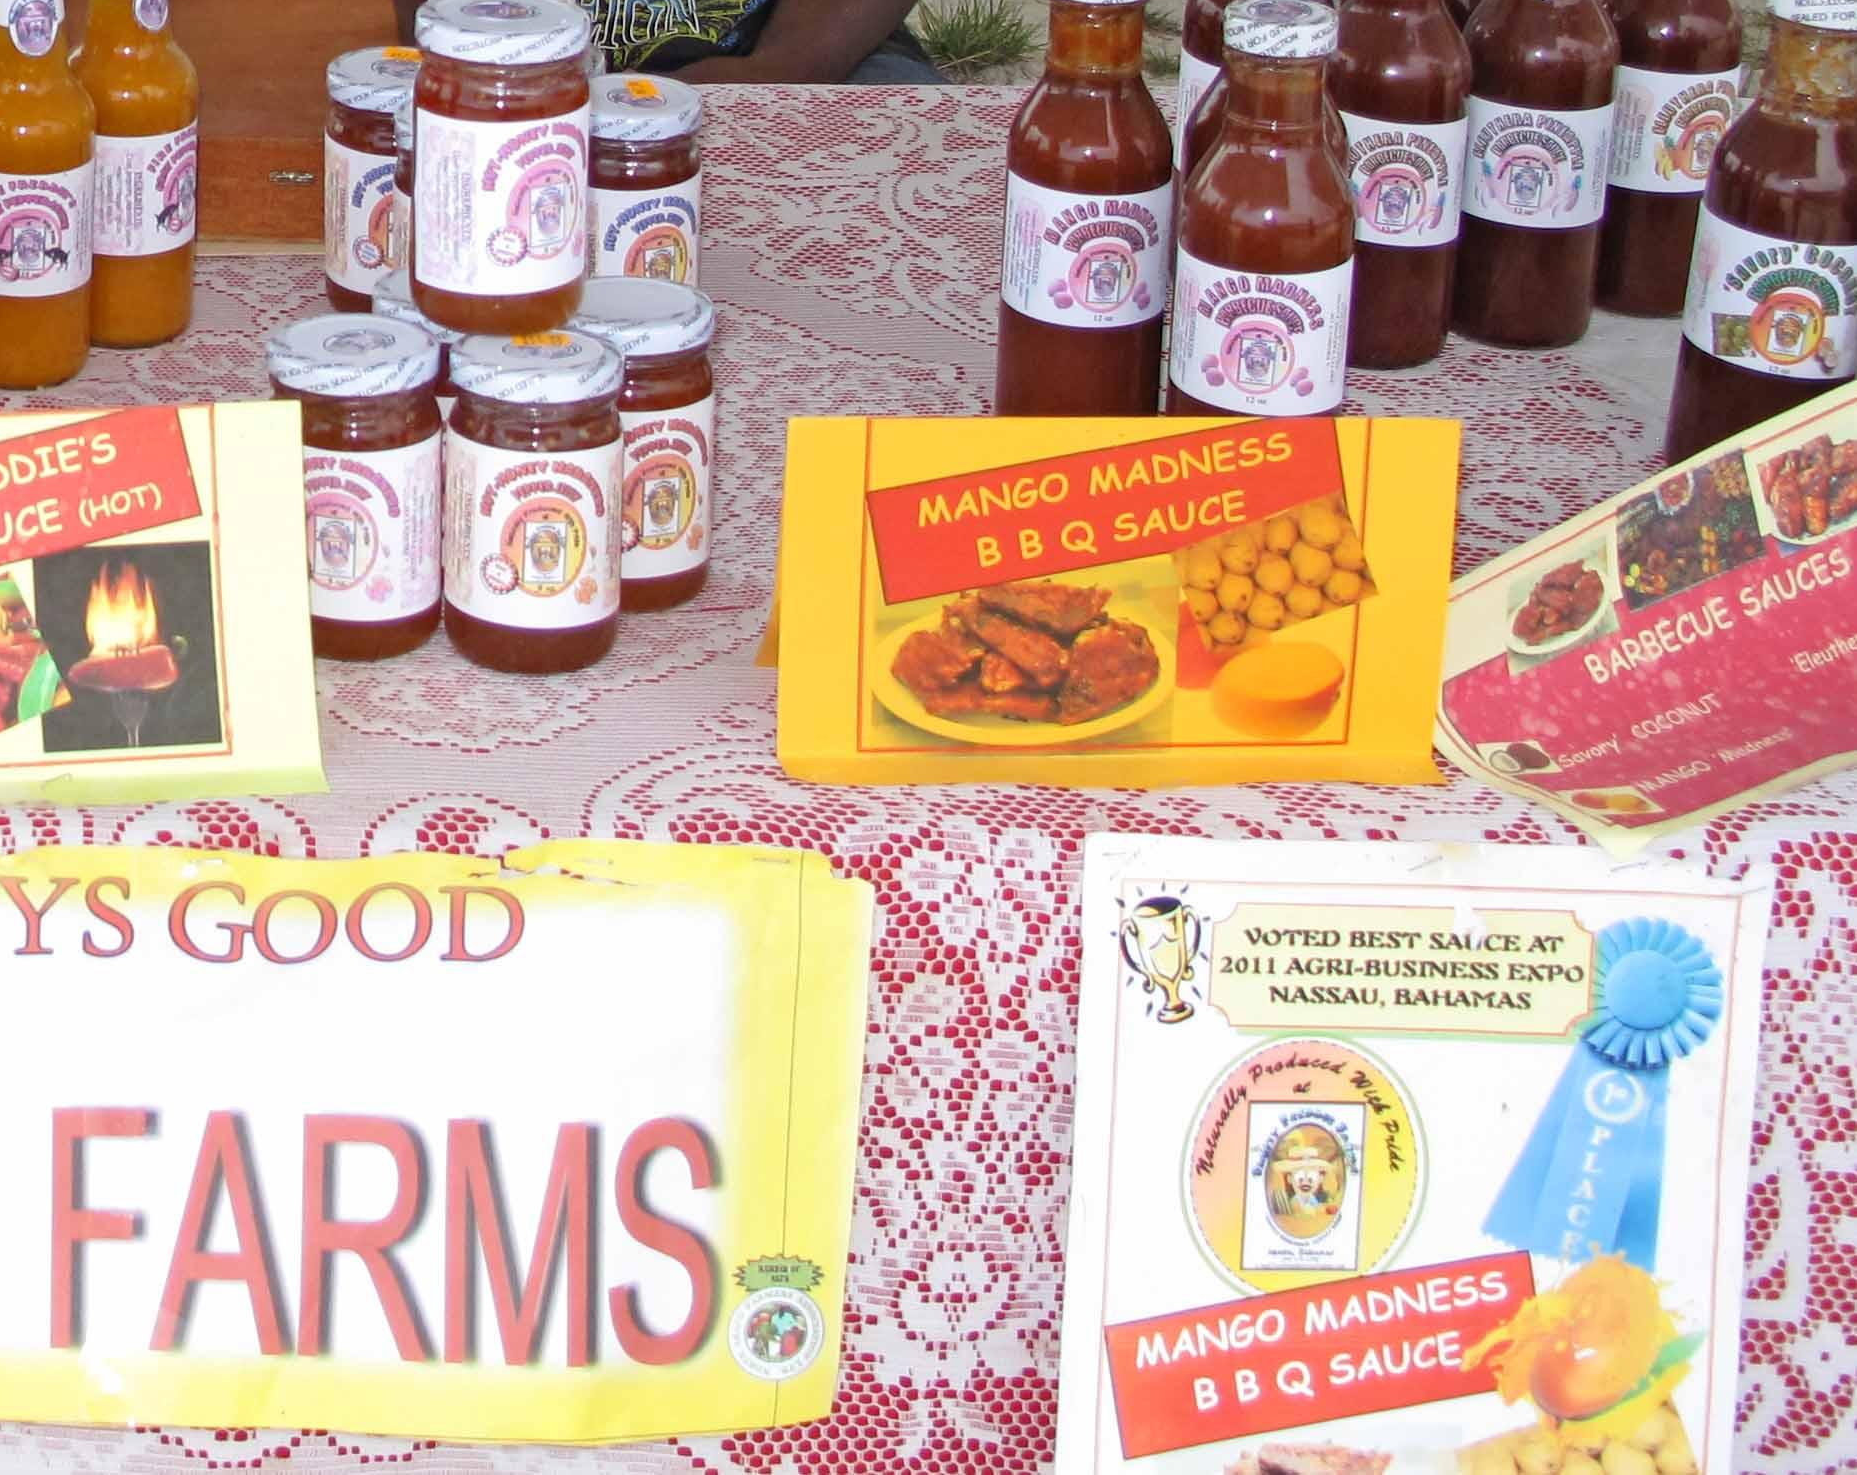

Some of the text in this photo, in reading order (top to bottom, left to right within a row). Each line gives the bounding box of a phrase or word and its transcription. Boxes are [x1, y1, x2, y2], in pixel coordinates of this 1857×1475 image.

[1042, 200, 1101, 246] MANGO
[1197, 275, 1251, 319] MANGO
[917, 430, 1294, 528] MANGO MADNESS
[78, 481, 164, 529] (HOT)
[976, 488, 1247, 568] B B Q SAUCE
[1582, 546, 1853, 686] BARBECUE SAUCES
[1789, 632, 1857, 675] 'Eleuthe
[1630, 692, 1722, 742] COCONUT
[1634, 758, 1712, 796] MANGO
[166, 879, 528, 965] GOOD
[1243, 925, 1342, 953] VOTED
[1347, 928, 1424, 952] BEST
[1530, 933, 1565, 955] AT
[1218, 957, 1586, 985] 2011 AGRI-BUSINESS EXPO
[1268, 985, 1532, 1013] NASSAU, BAHAMAS
[1194, 1085, 1249, 1178] Naturally
[1247, 1052, 1348, 1086] Produced
[1348, 1069, 1392, 1117] With
[1380, 1118, 1407, 1175] Pride
[48, 1105, 724, 1369] FARMS
[1135, 1269, 1510, 1370] MANGO MADNESS
[1194, 1331, 1464, 1412] B B Q SAUCE
